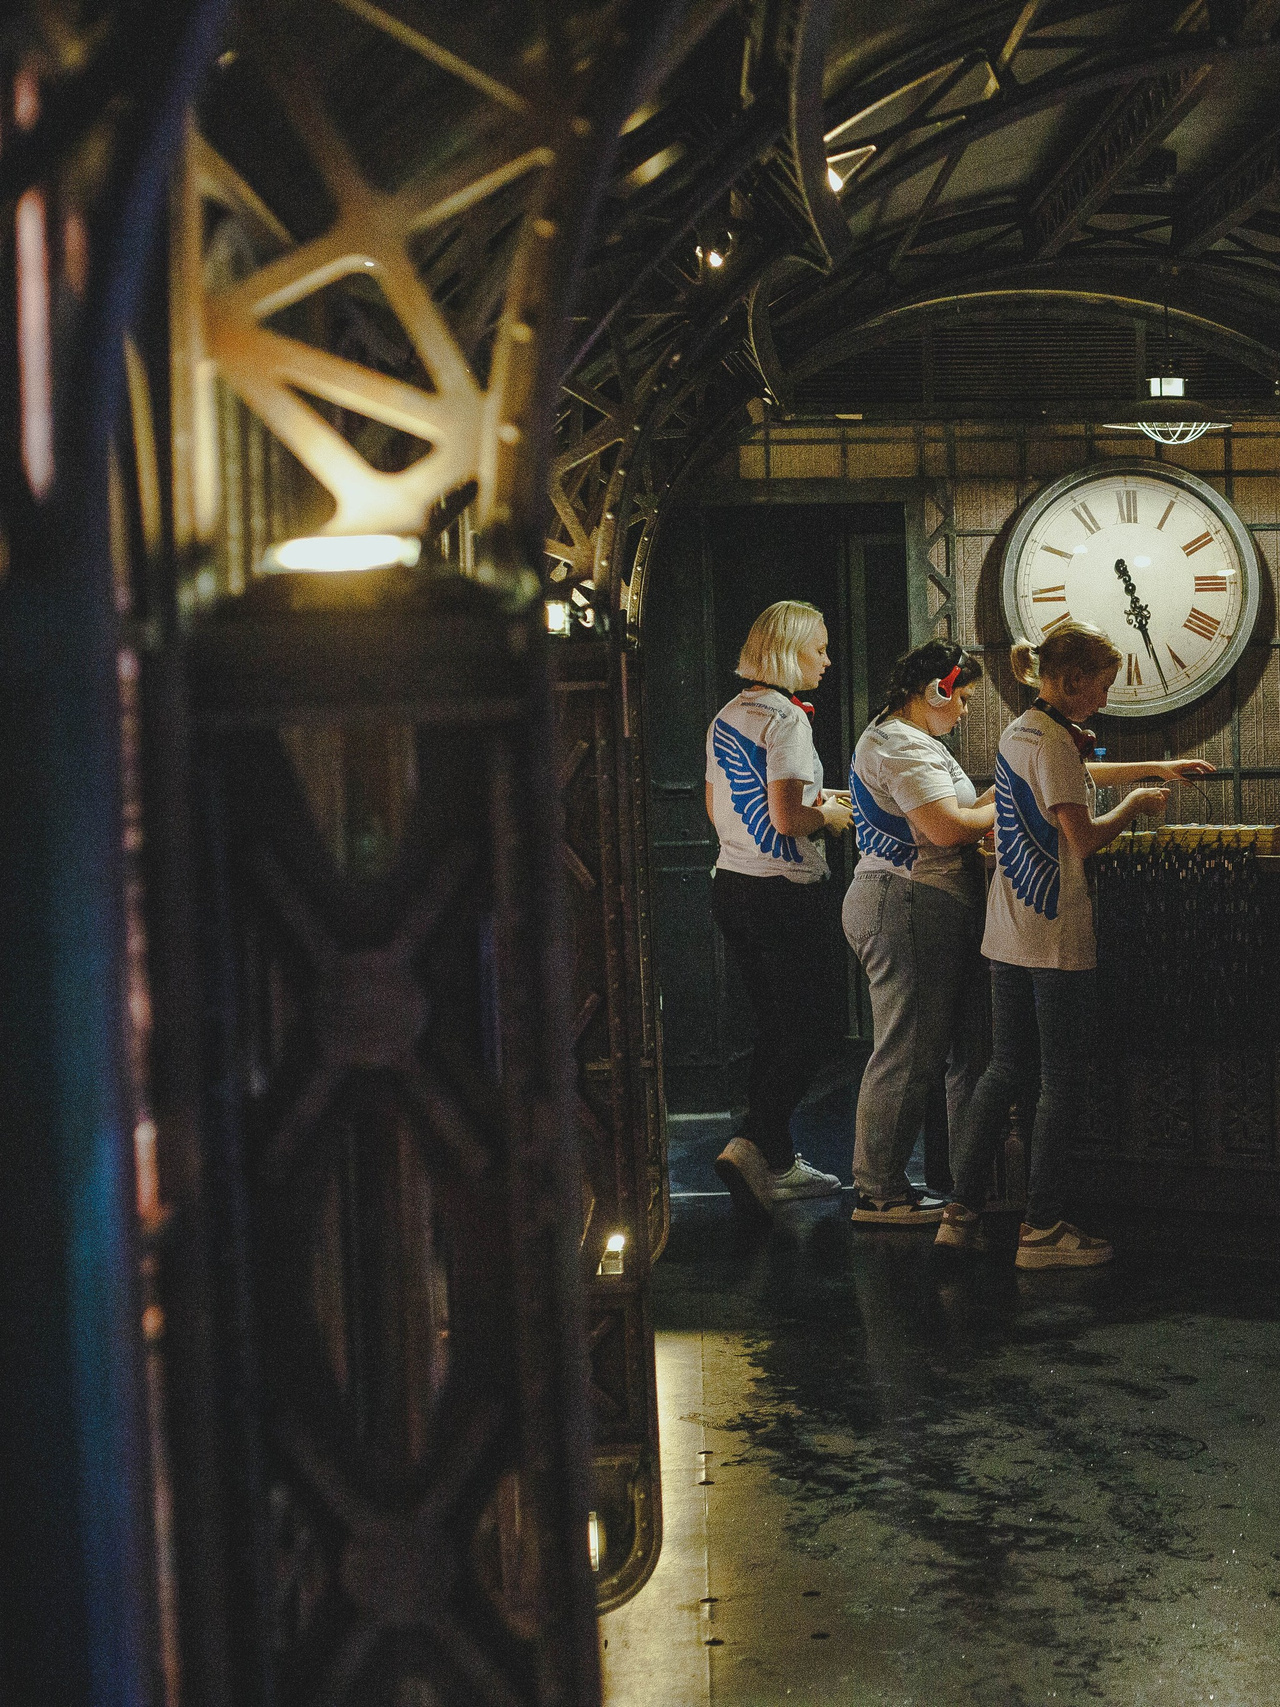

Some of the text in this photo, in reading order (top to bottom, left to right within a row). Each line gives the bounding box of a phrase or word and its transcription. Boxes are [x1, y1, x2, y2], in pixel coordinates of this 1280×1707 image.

[1154, 499, 1177, 532] I
[1181, 530, 1214, 557] II
[1194, 575, 1227, 593] III
